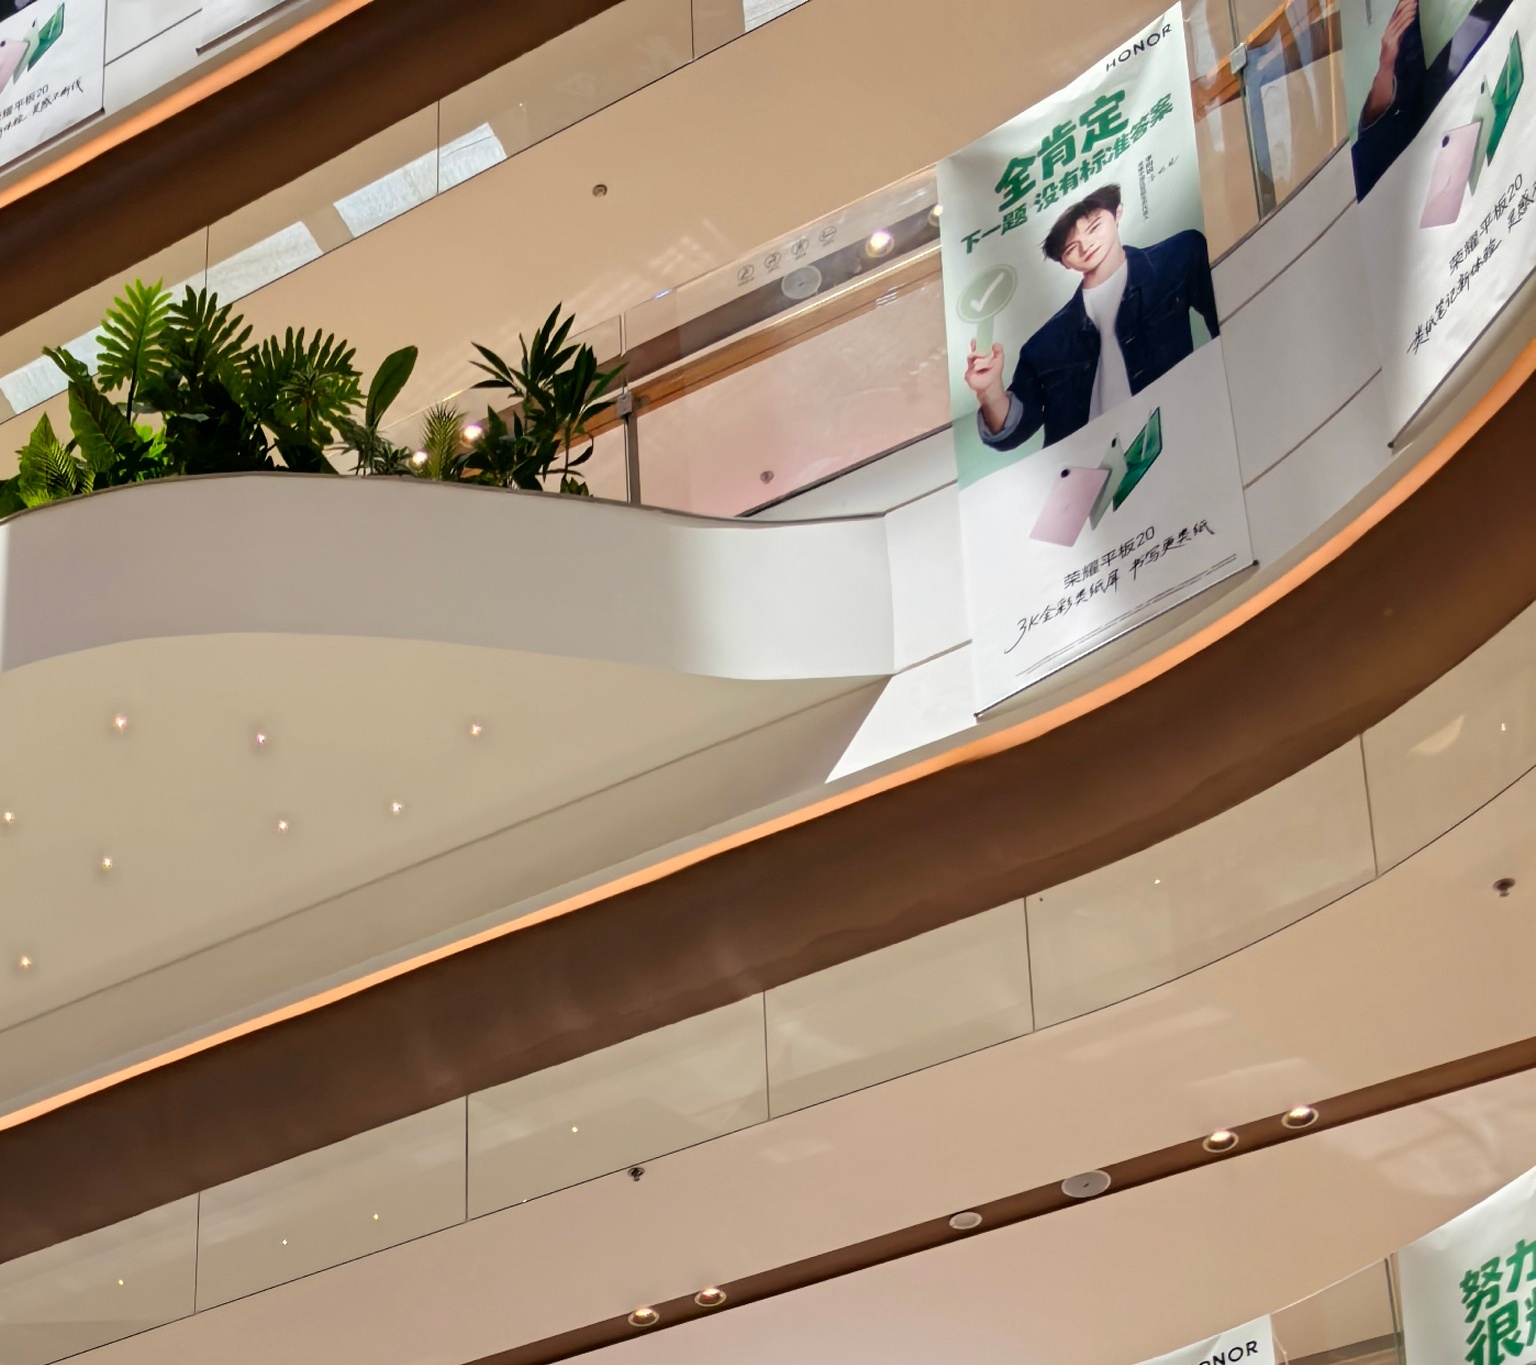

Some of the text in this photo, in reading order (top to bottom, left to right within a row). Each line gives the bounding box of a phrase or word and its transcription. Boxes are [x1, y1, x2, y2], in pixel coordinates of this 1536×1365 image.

[1105, 23, 1173, 72] HONOR
[961, 202, 1028, 254] 下一题
[1035, 92, 1174, 213] 没有标准答案
[994, 89, 1130, 213] 全肯定
[1449, 173, 1523, 276] 荣耀平板20
[1063, 525, 1155, 589] 荣耀平板20
